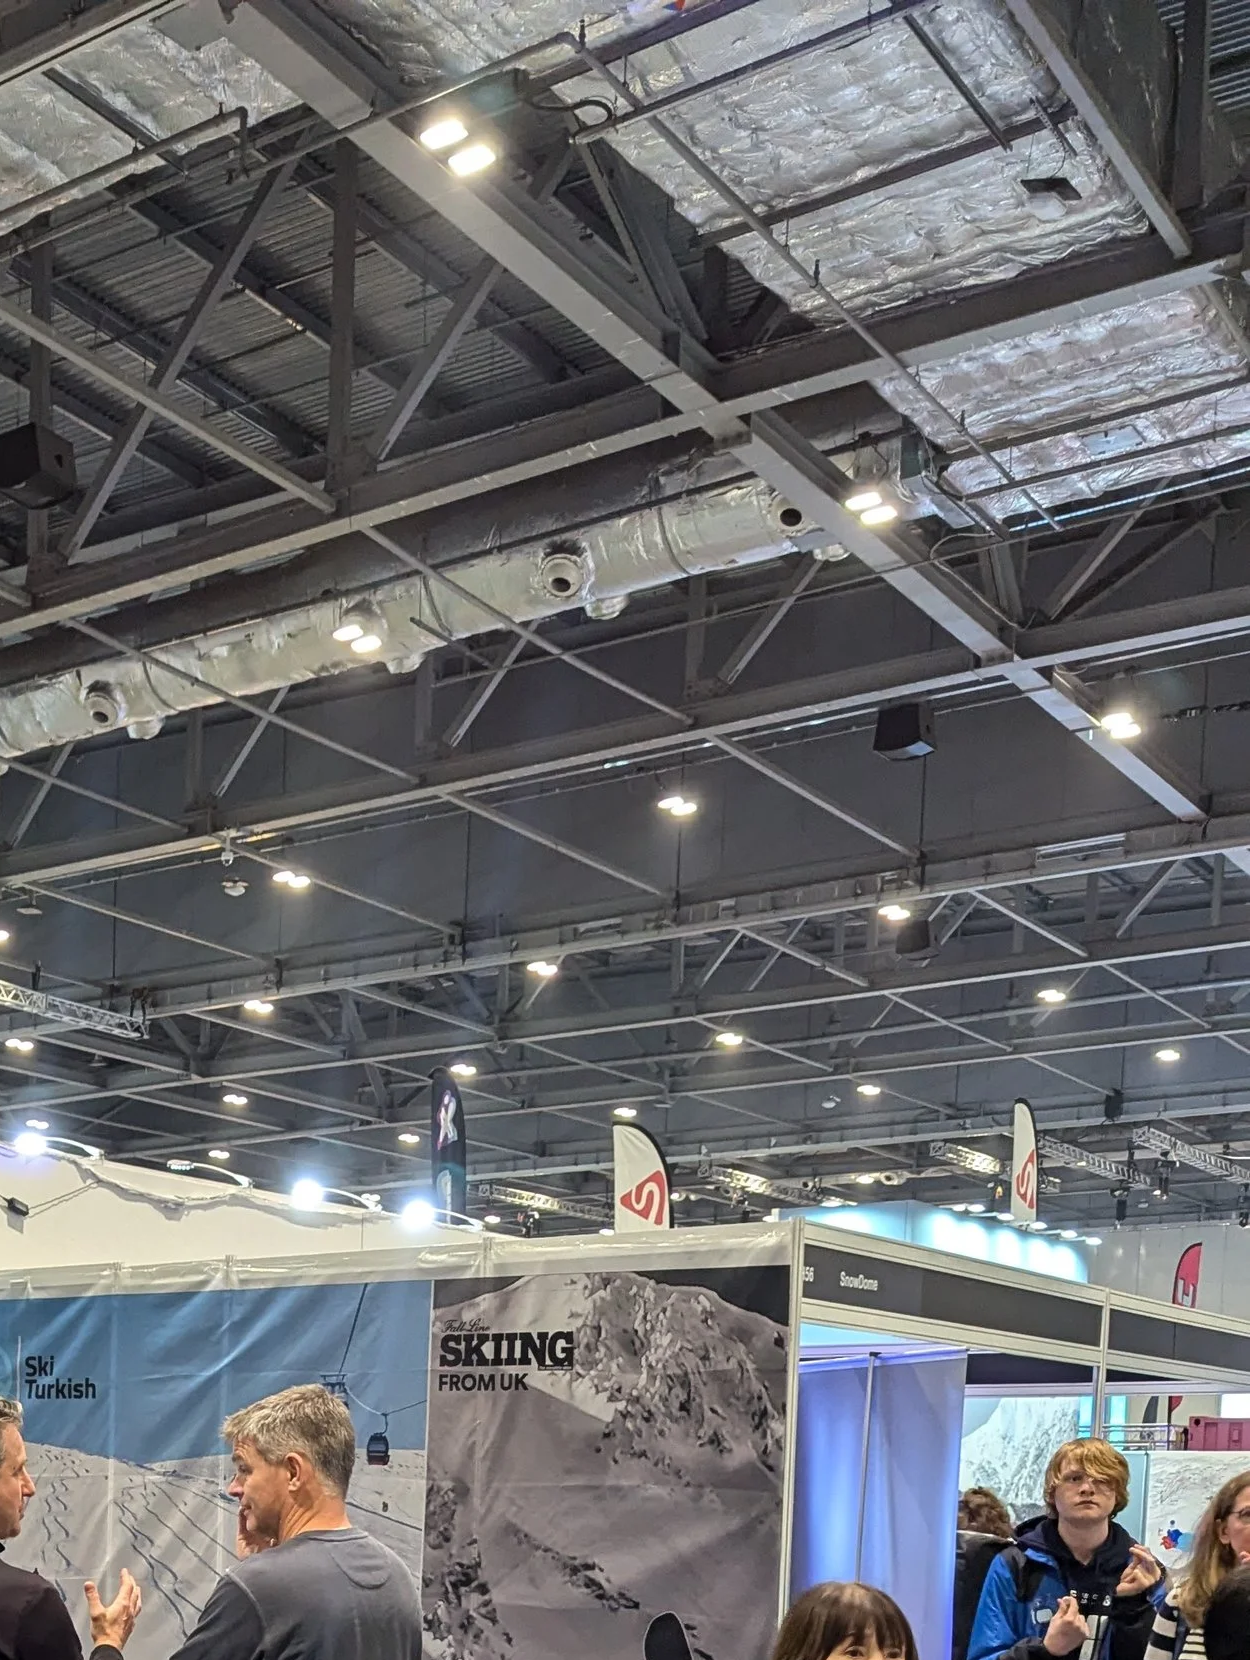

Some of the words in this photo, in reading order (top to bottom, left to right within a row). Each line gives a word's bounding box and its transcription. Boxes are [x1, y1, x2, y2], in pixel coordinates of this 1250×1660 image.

[840, 1271, 879, 1292] SnowDome
[439, 1331, 576, 1367] SKIING
[25, 1355, 55, 1377] Ski
[24, 1377, 97, 1400] Turkish
[438, 1374, 496, 1392] FROM
[501, 1373, 529, 1391] UK
